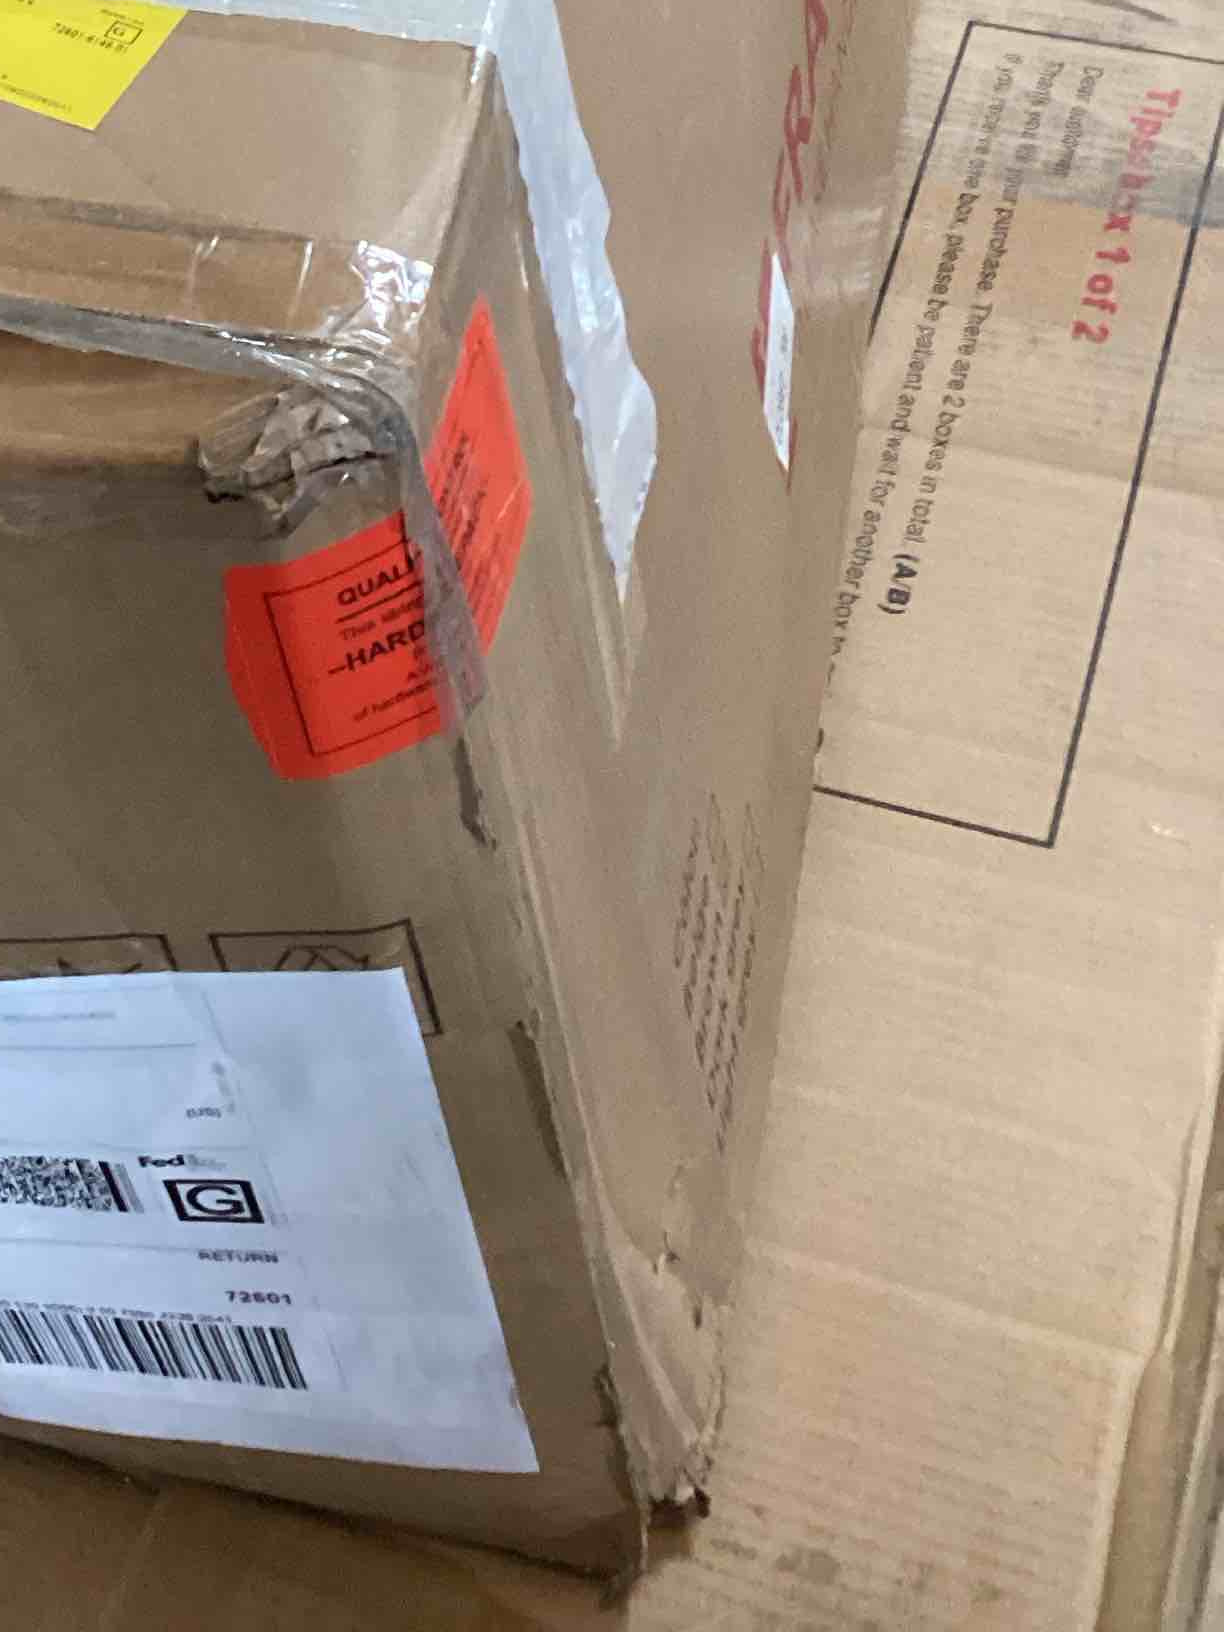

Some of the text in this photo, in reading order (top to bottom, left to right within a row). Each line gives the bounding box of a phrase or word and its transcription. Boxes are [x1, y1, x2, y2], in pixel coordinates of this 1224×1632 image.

[932, 232, 965, 295] please
[1095, 247, 1131, 264] 1
[923, 297, 950, 322] be
[1080, 273, 1119, 315] of
[957, 302, 994, 357] There
[1070, 319, 1110, 345] 2
[901, 324, 937, 391] patient
[947, 358, 971, 391] are
[889, 393, 918, 433] and
[941, 393, 966, 410] 2
[924, 410, 961, 472] boxes
[869, 478, 896, 508] for
[919, 475, 937, 494] in
[844, 509, 882, 590] another
[833, 591, 861, 631] box
[186, 1184, 247, 1216] G
[197, 1248, 280, 1265] RETURN
[223, 1289, 293, 1306] 72601
